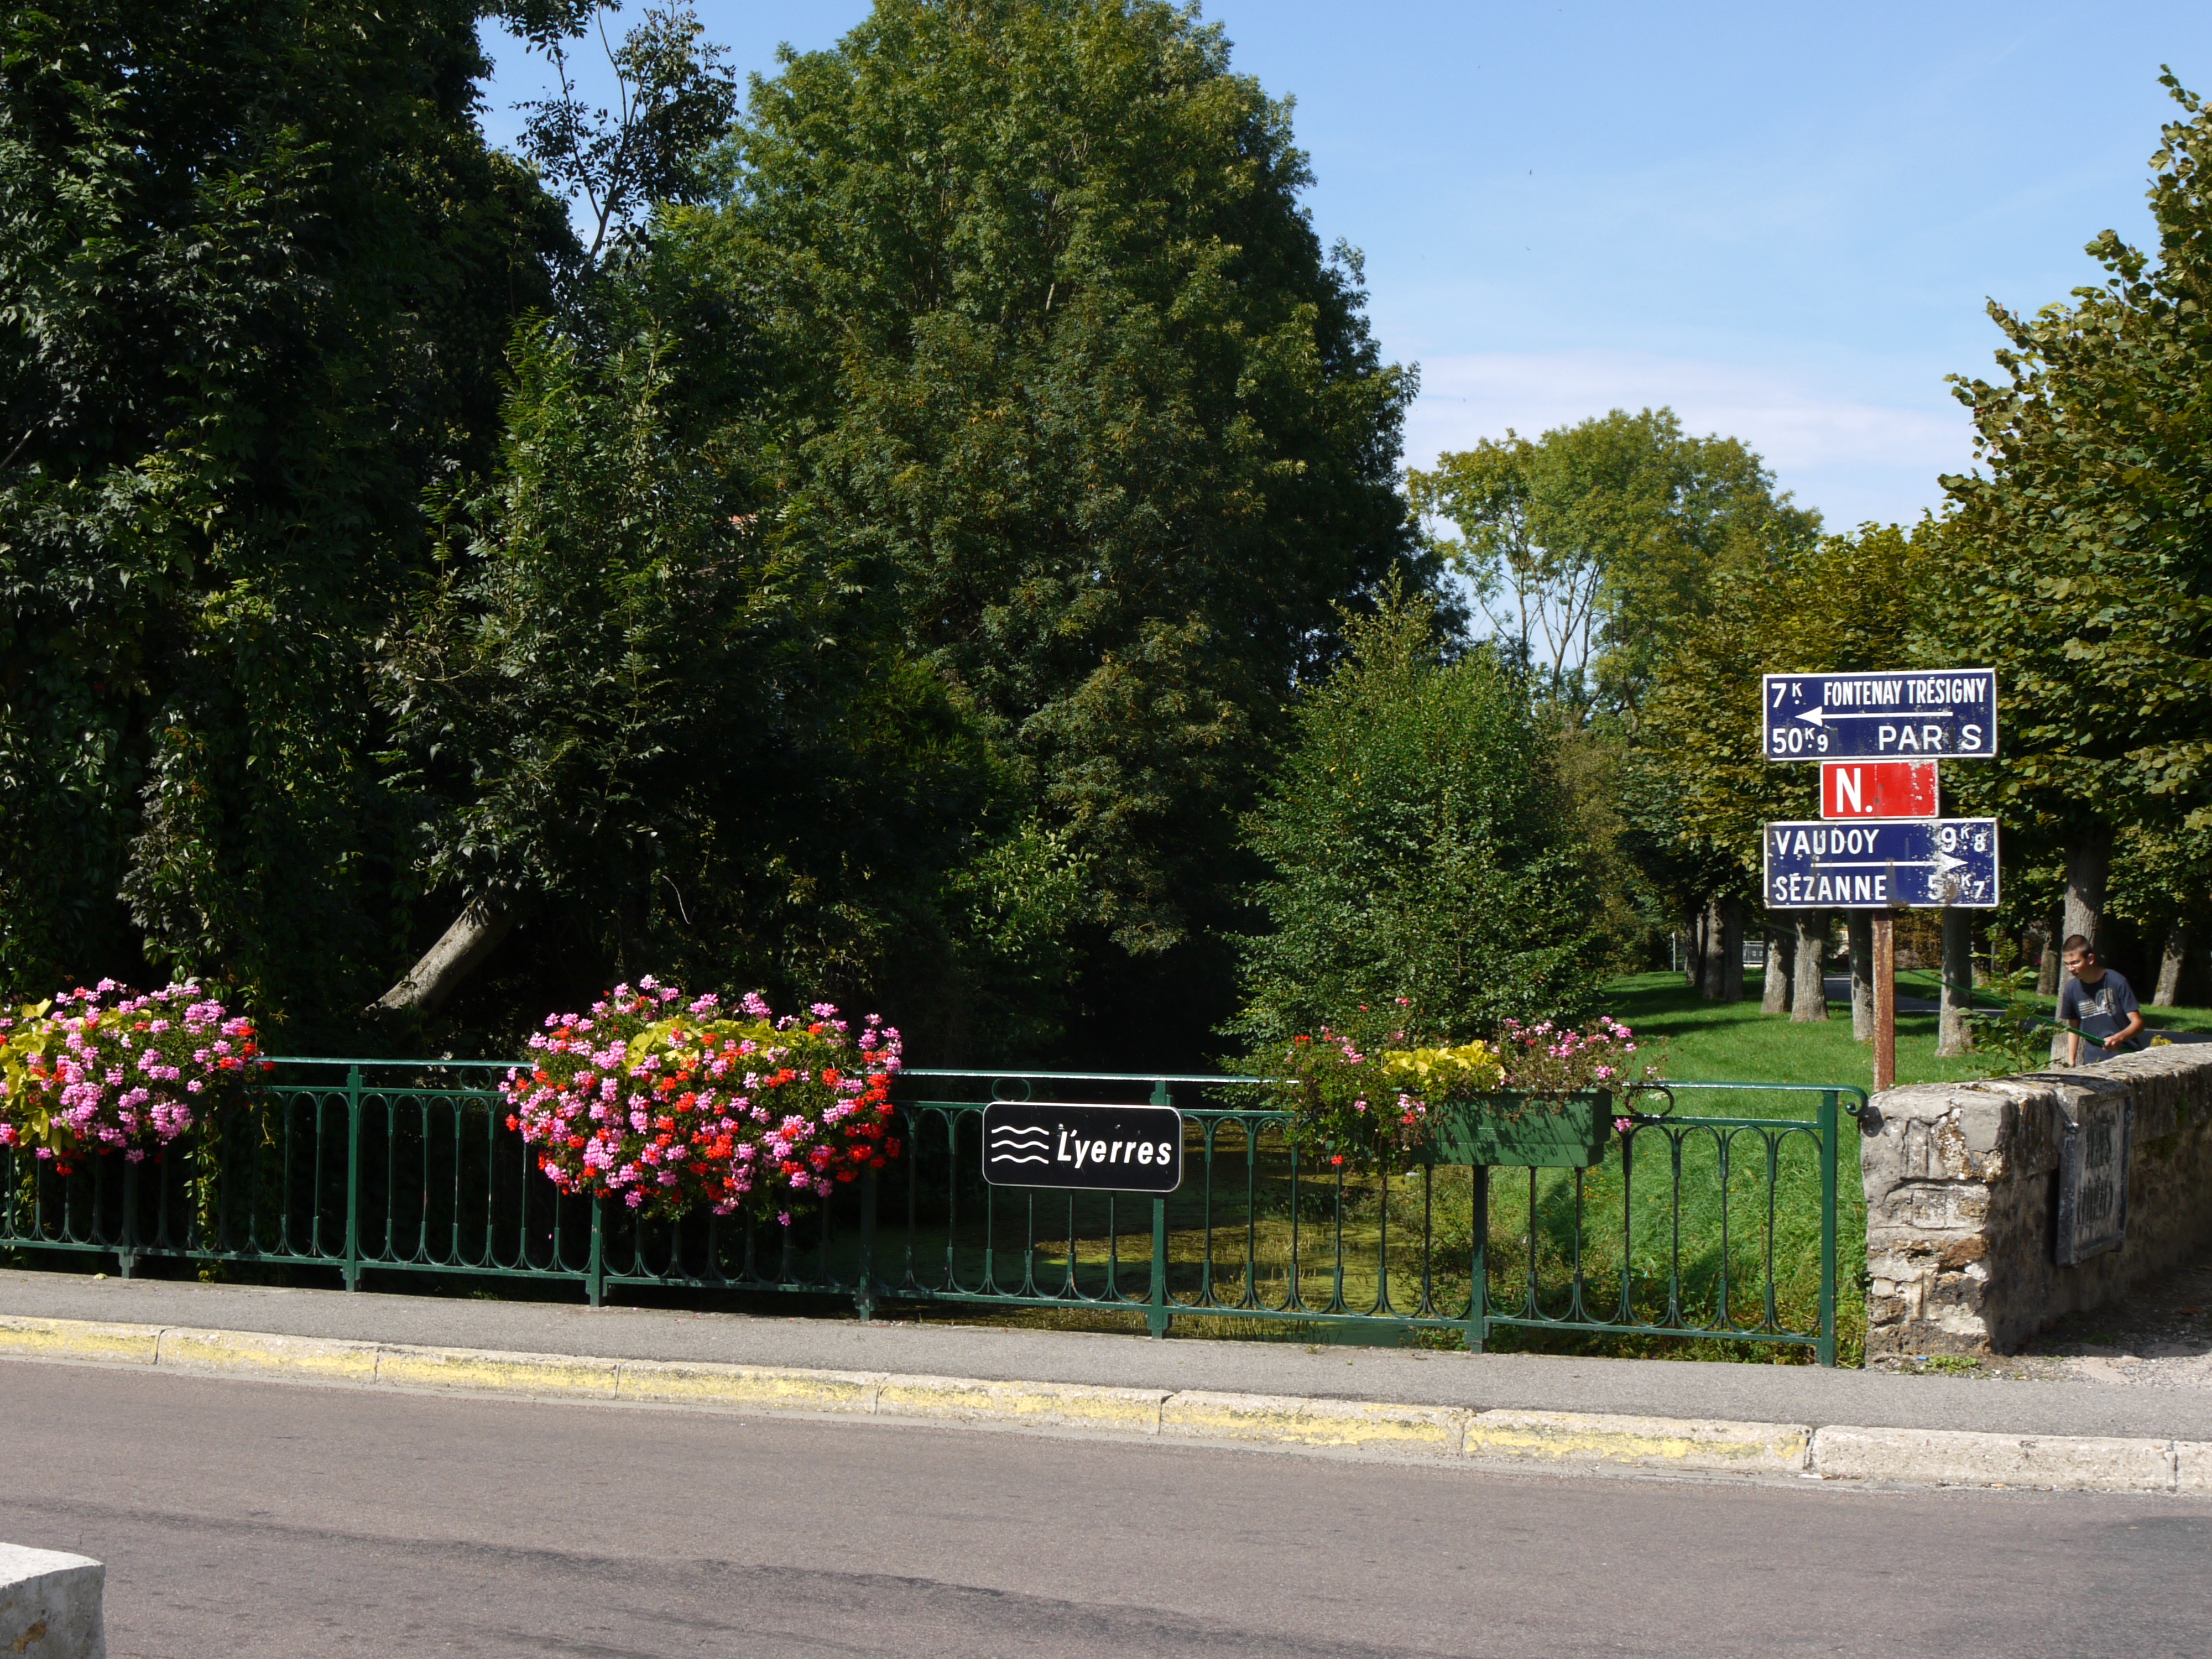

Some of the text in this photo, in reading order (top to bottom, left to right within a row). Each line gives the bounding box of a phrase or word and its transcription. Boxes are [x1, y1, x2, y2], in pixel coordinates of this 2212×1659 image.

[1824, 680, 1903, 706] FONTENAY
[1907, 676, 1987, 704] TRÉSIGNY
[1775, 829, 1880, 855] VAUDOY
[1775, 873, 1887, 901] SÉZANNE
